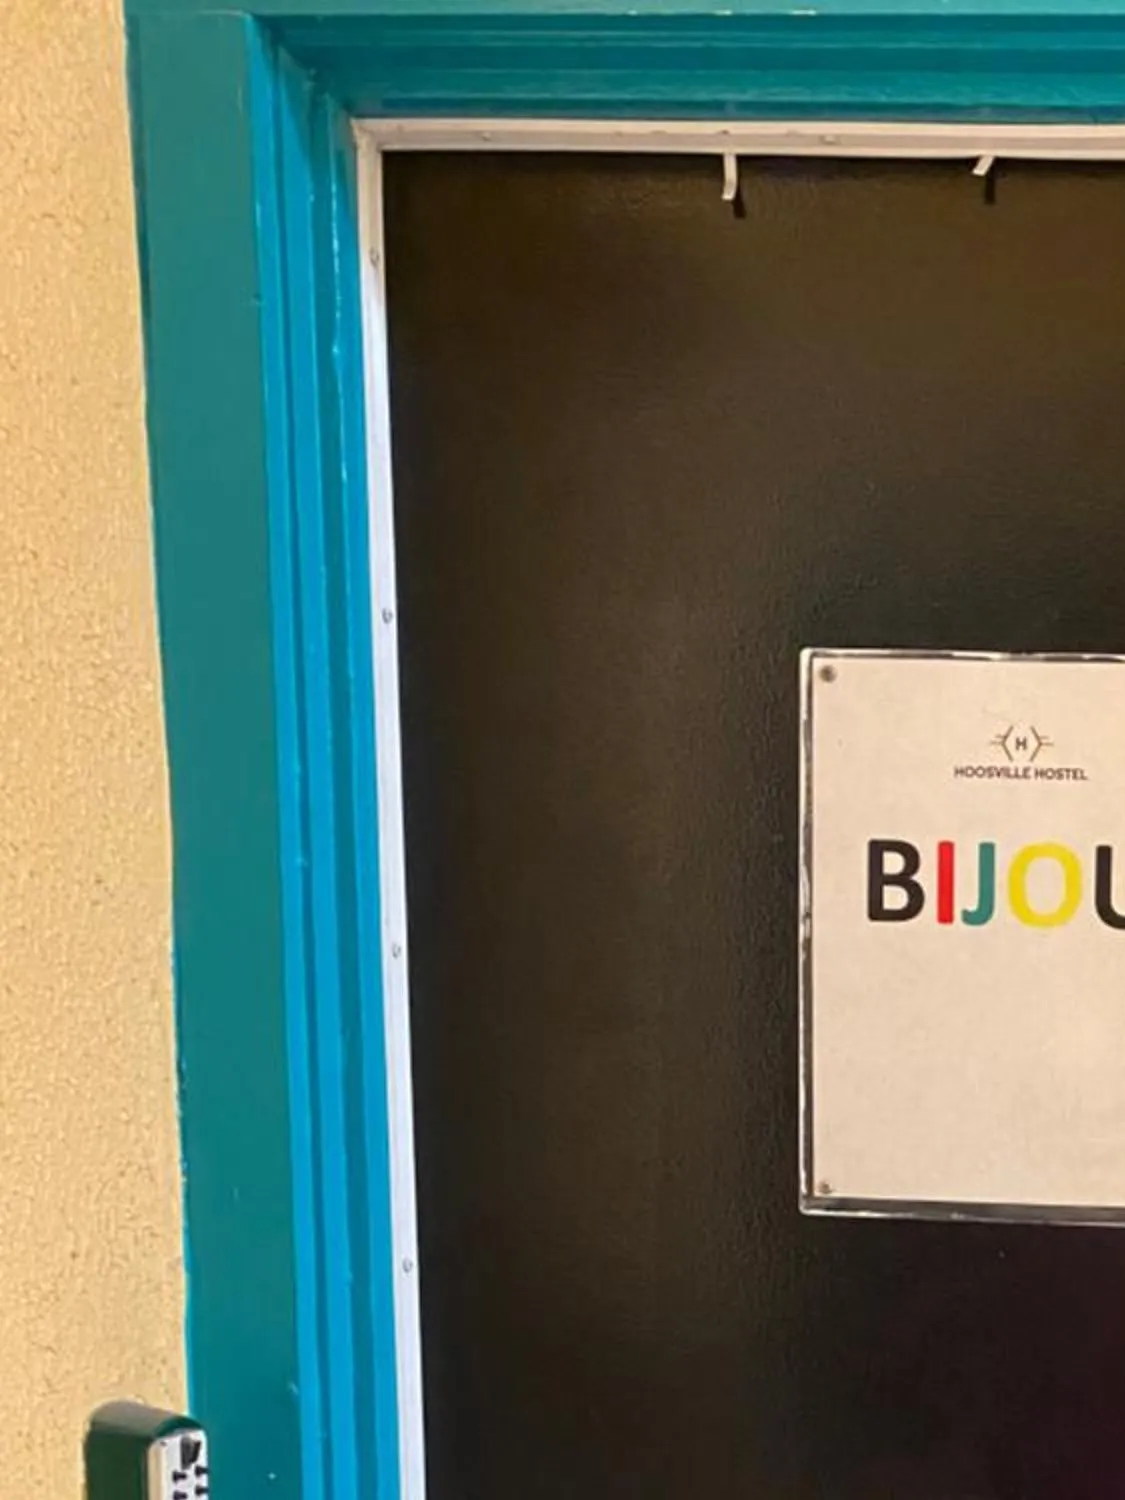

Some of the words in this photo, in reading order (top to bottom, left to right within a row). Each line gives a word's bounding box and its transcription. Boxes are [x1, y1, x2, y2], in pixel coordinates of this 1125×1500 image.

[1015, 737, 1027, 750] H
[953, 765, 1031, 780] HOOSVILLE
[1034, 767, 1088, 781] HOSTEL
